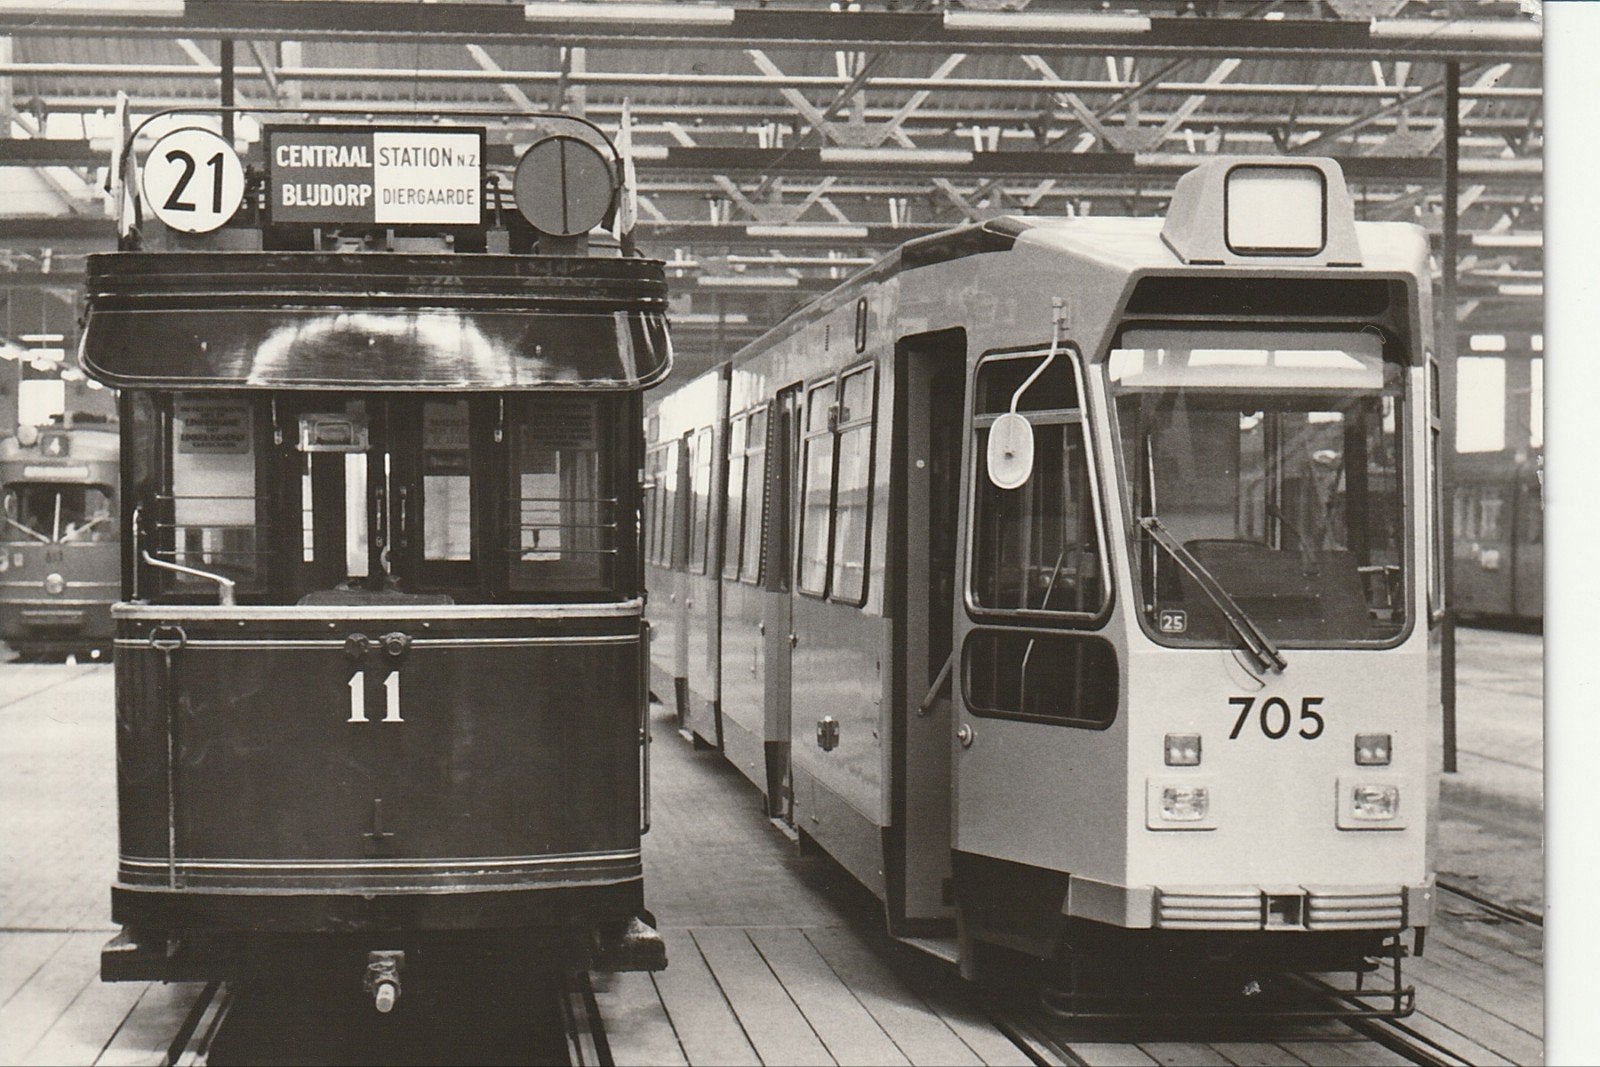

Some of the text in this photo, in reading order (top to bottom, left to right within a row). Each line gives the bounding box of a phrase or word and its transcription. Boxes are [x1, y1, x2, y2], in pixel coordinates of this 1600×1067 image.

[275, 144, 372, 168] CENTRAAL
[379, 146, 453, 168] STATION
[162, 149, 225, 214] 21
[383, 188, 475, 206] DIERGAARDE
[1162, 614, 1183, 630] 25
[347, 670, 405, 723] 11
[1228, 696, 1325, 740] 705
